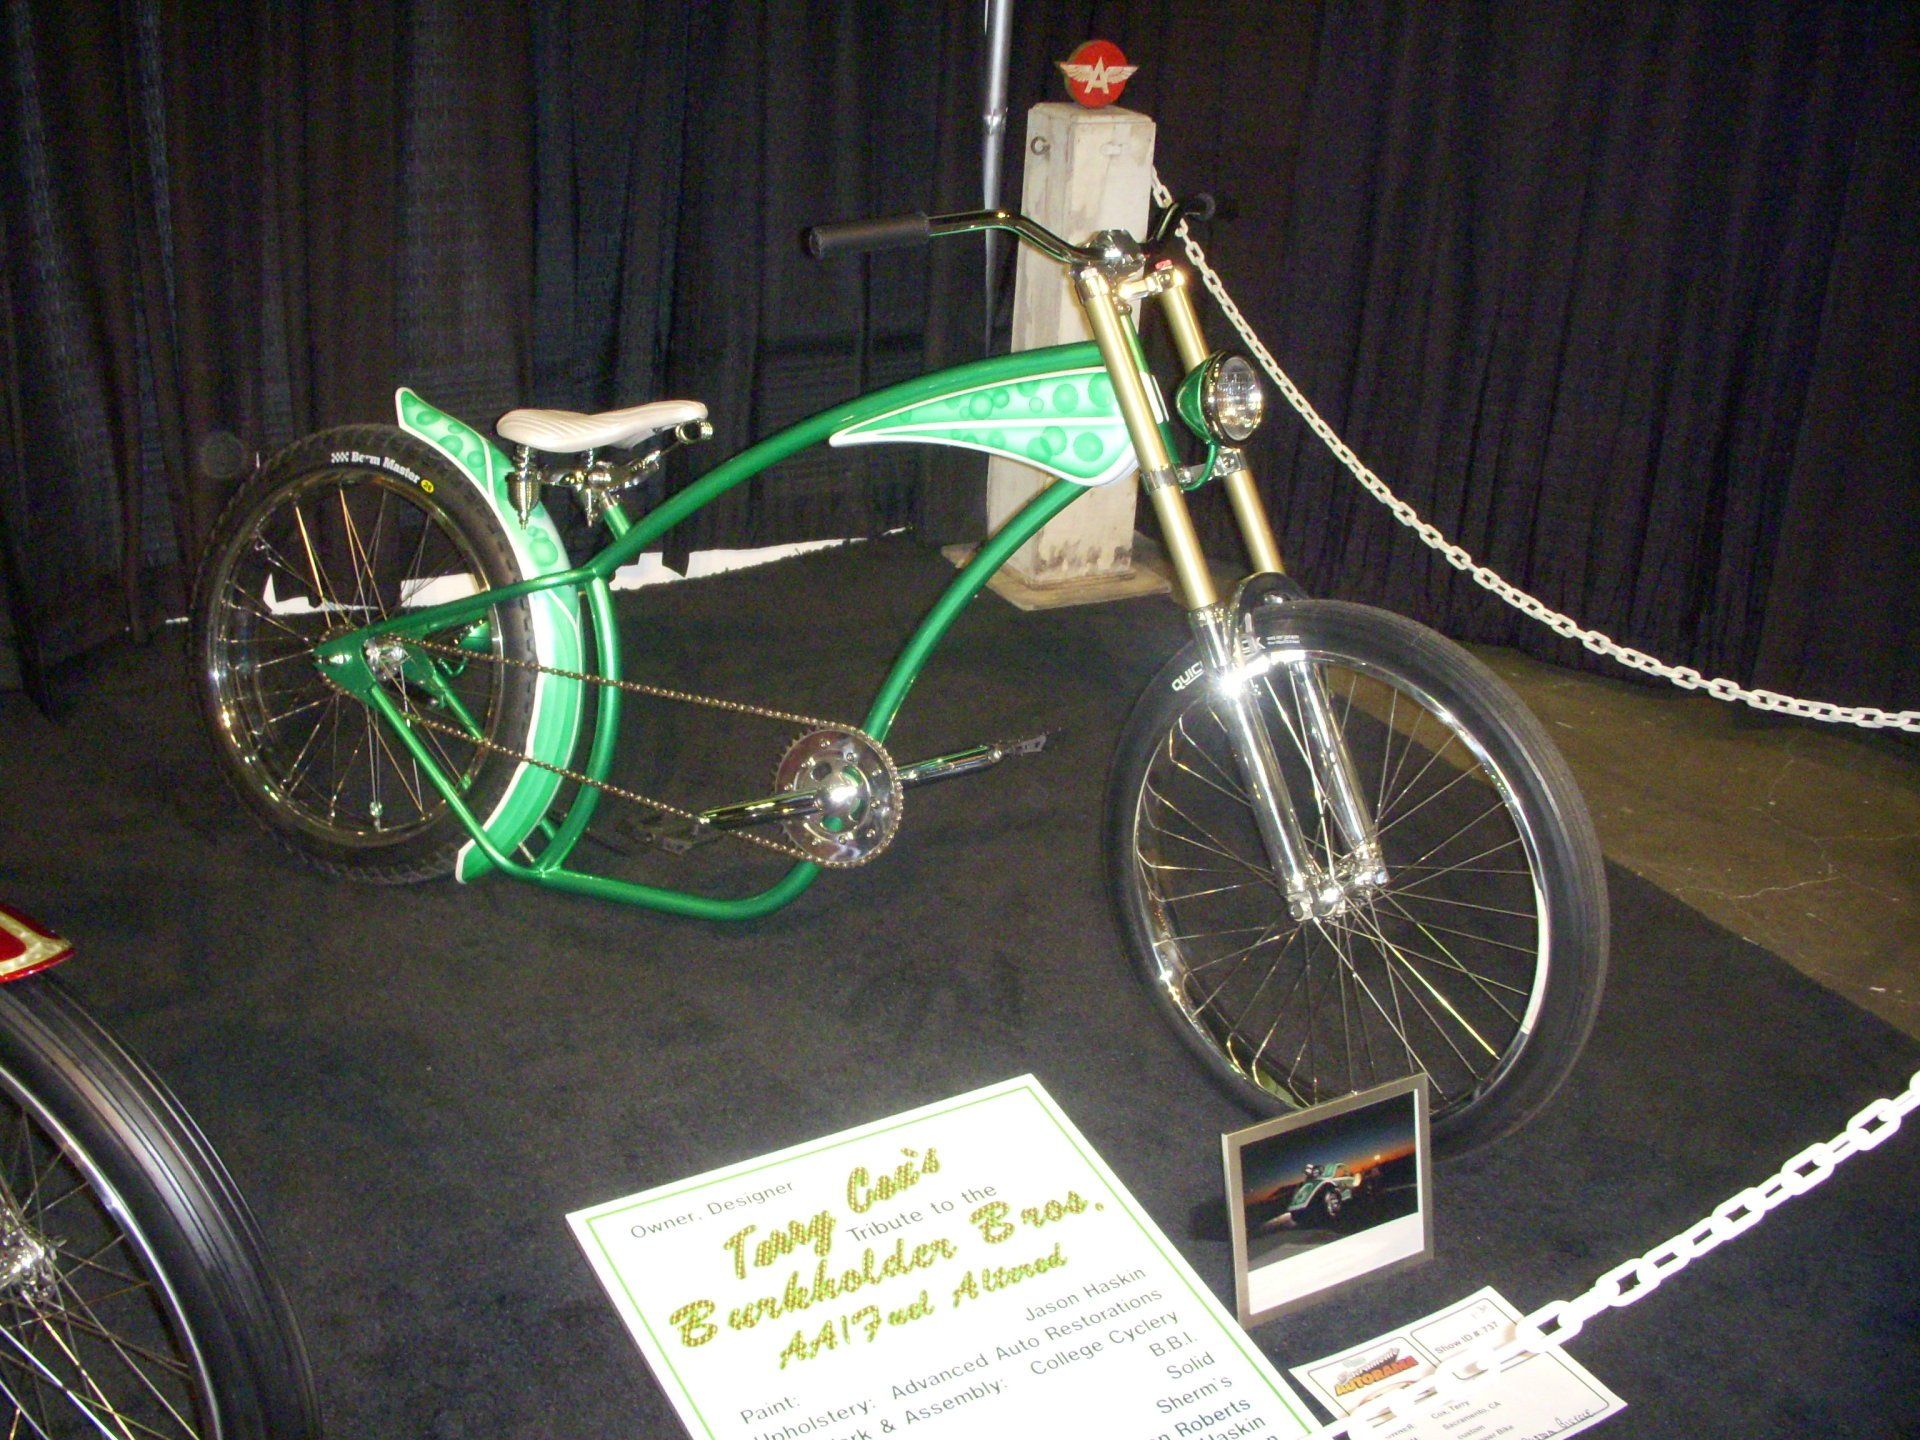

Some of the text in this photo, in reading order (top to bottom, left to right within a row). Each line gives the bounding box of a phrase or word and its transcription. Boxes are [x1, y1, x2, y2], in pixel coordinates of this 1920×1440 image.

[383, 457, 421, 484] Master
[1171, 660, 1205, 692] QUIC
[707, 1181, 794, 1216] Designer
[847, 1185, 998, 1243] Tribute to the
[669, 1190, 1105, 1348] Burkholder Bros.
[740, 1267, 1146, 1425] Paint: Jason Haskin
[891, 1353, 989, 1400] Advanced
[996, 1337, 1041, 1361] Auto
[1044, 1289, 1163, 1341] Restorations
[1434, 1339, 1461, 1354] Show
[1462, 1333, 1473, 1345] ID
[880, 1310, 1179, 1433] & Assembly: College Cyclery
[1166, 1351, 1215, 1379] Solid
[1334, 1355, 1419, 1396] AUTORAMA
[1156, 1376, 1233, 1414] Sherm's
[1488, 1401, 1502, 1410] CA
[1174, 1399, 1251, 1437] Roberts
